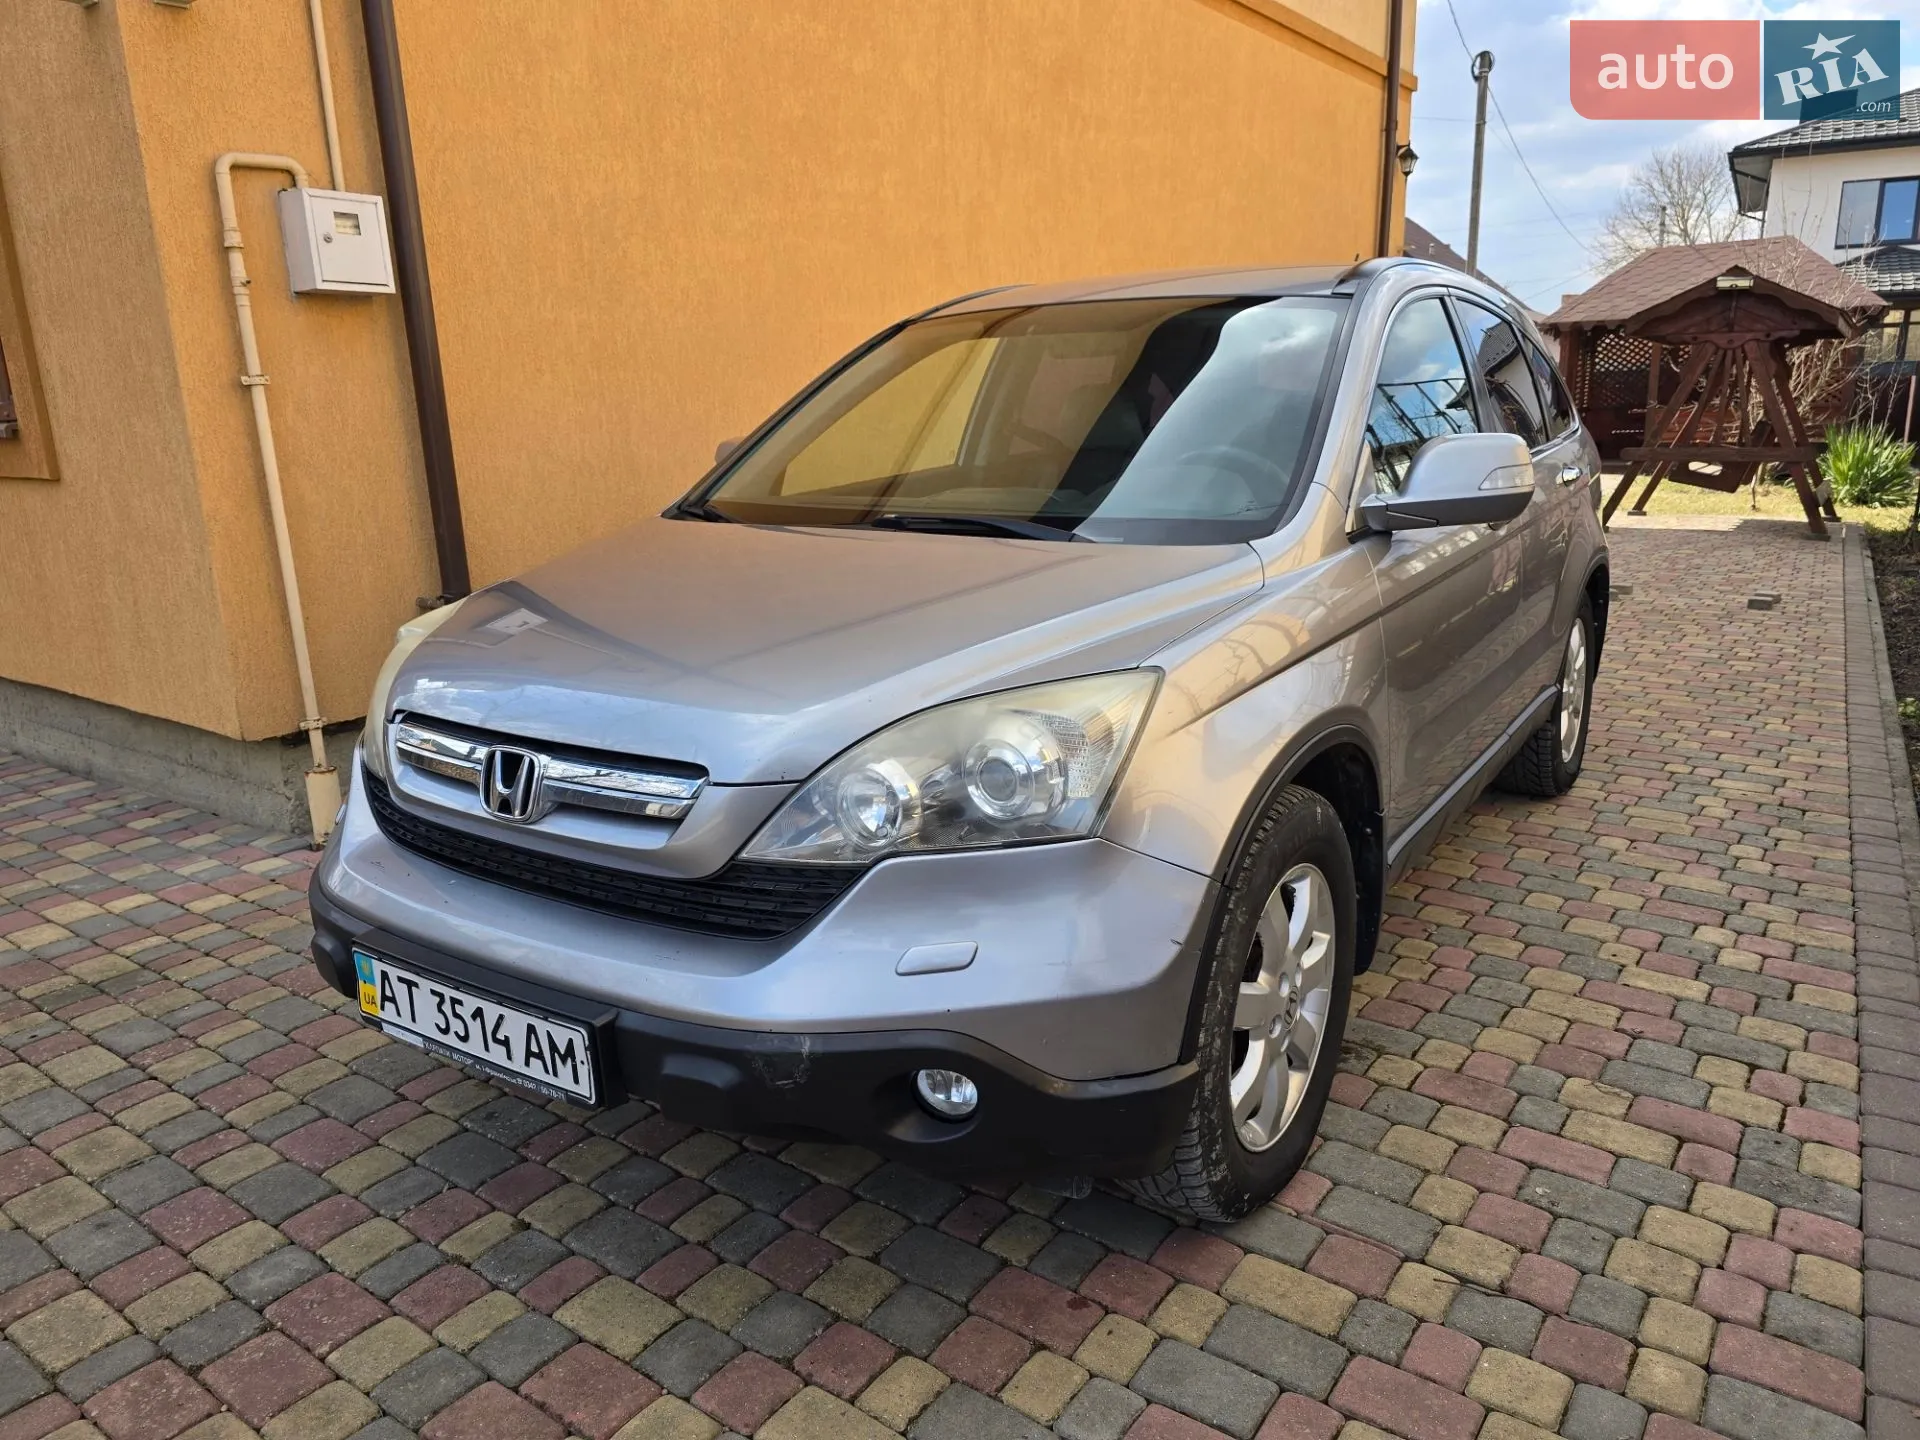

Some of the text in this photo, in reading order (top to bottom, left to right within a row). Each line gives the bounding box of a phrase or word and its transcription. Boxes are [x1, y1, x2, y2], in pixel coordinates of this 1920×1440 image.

[363, 991, 378, 1009] UA
[379, 969, 581, 1086] AT 3514 AM
